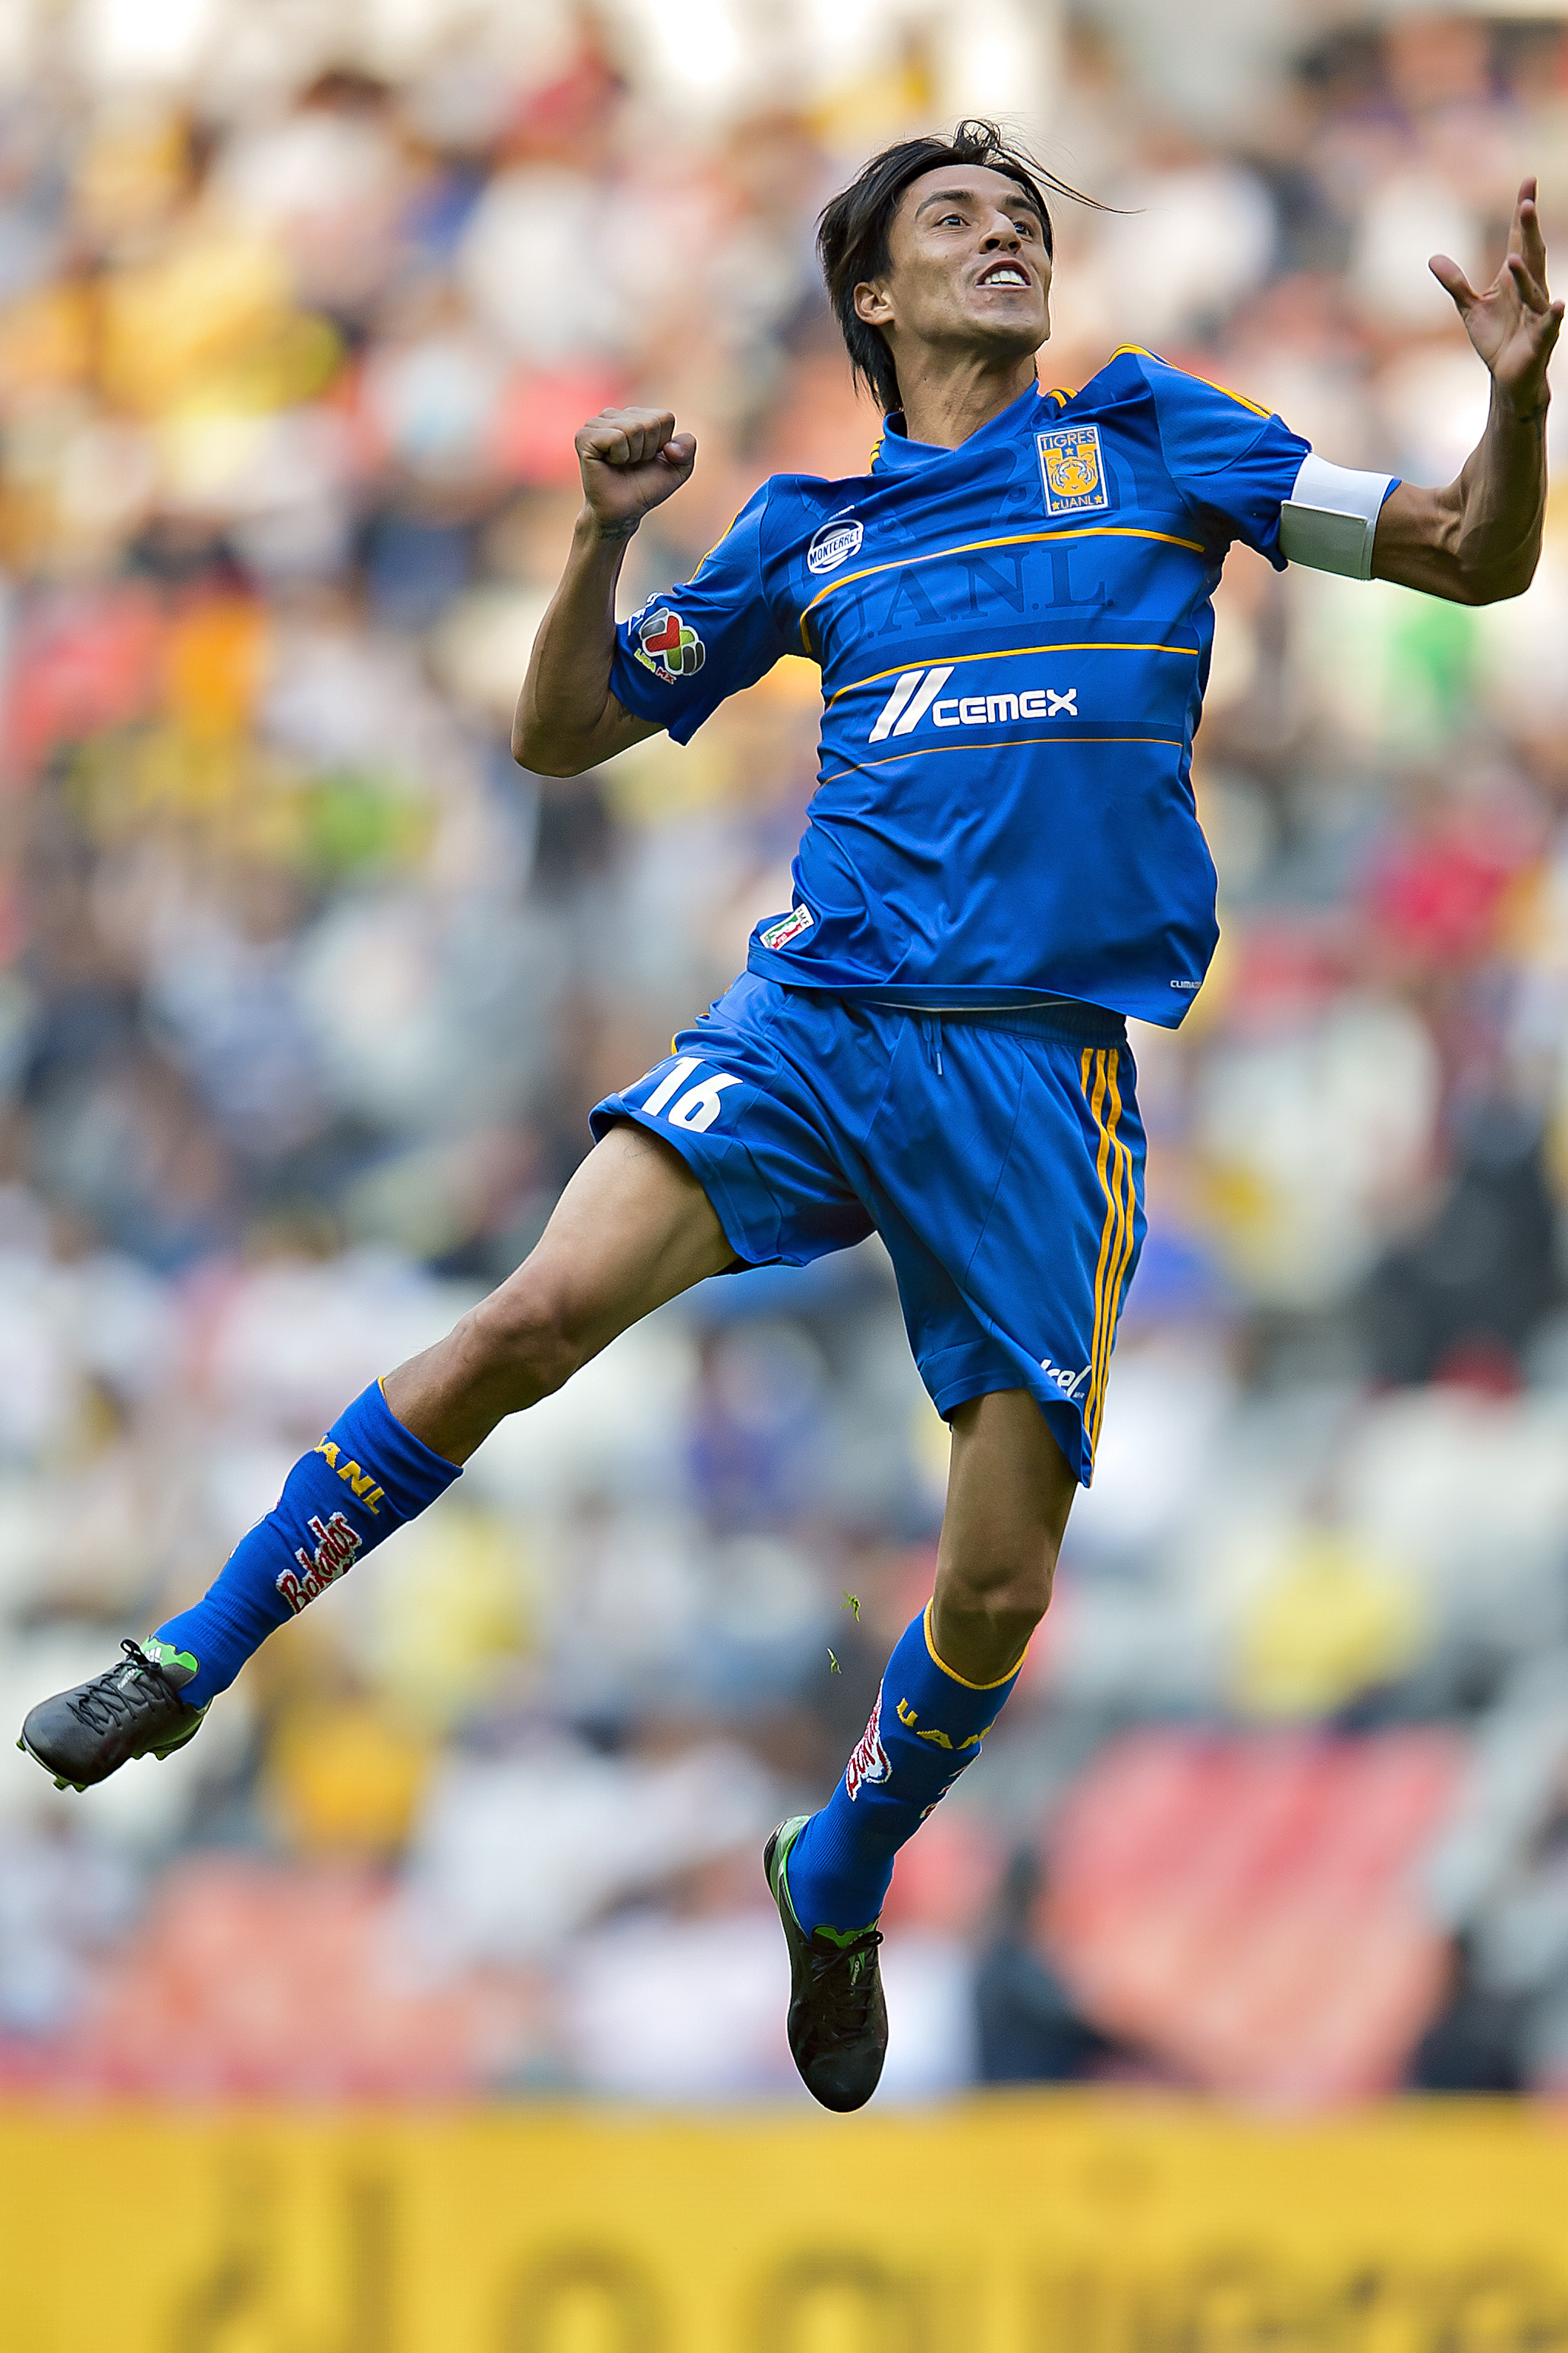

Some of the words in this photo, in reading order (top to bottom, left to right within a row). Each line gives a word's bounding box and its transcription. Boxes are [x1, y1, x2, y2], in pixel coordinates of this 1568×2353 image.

[1041, 430, 1095, 449] TIGRES
[1061, 495, 1094, 509] UANL
[809, 528, 862, 566] MONTERREY
[655, 666, 677, 685] MX
[932, 688, 1078, 728] CEMEX
[641, 1056, 744, 1133] 16
